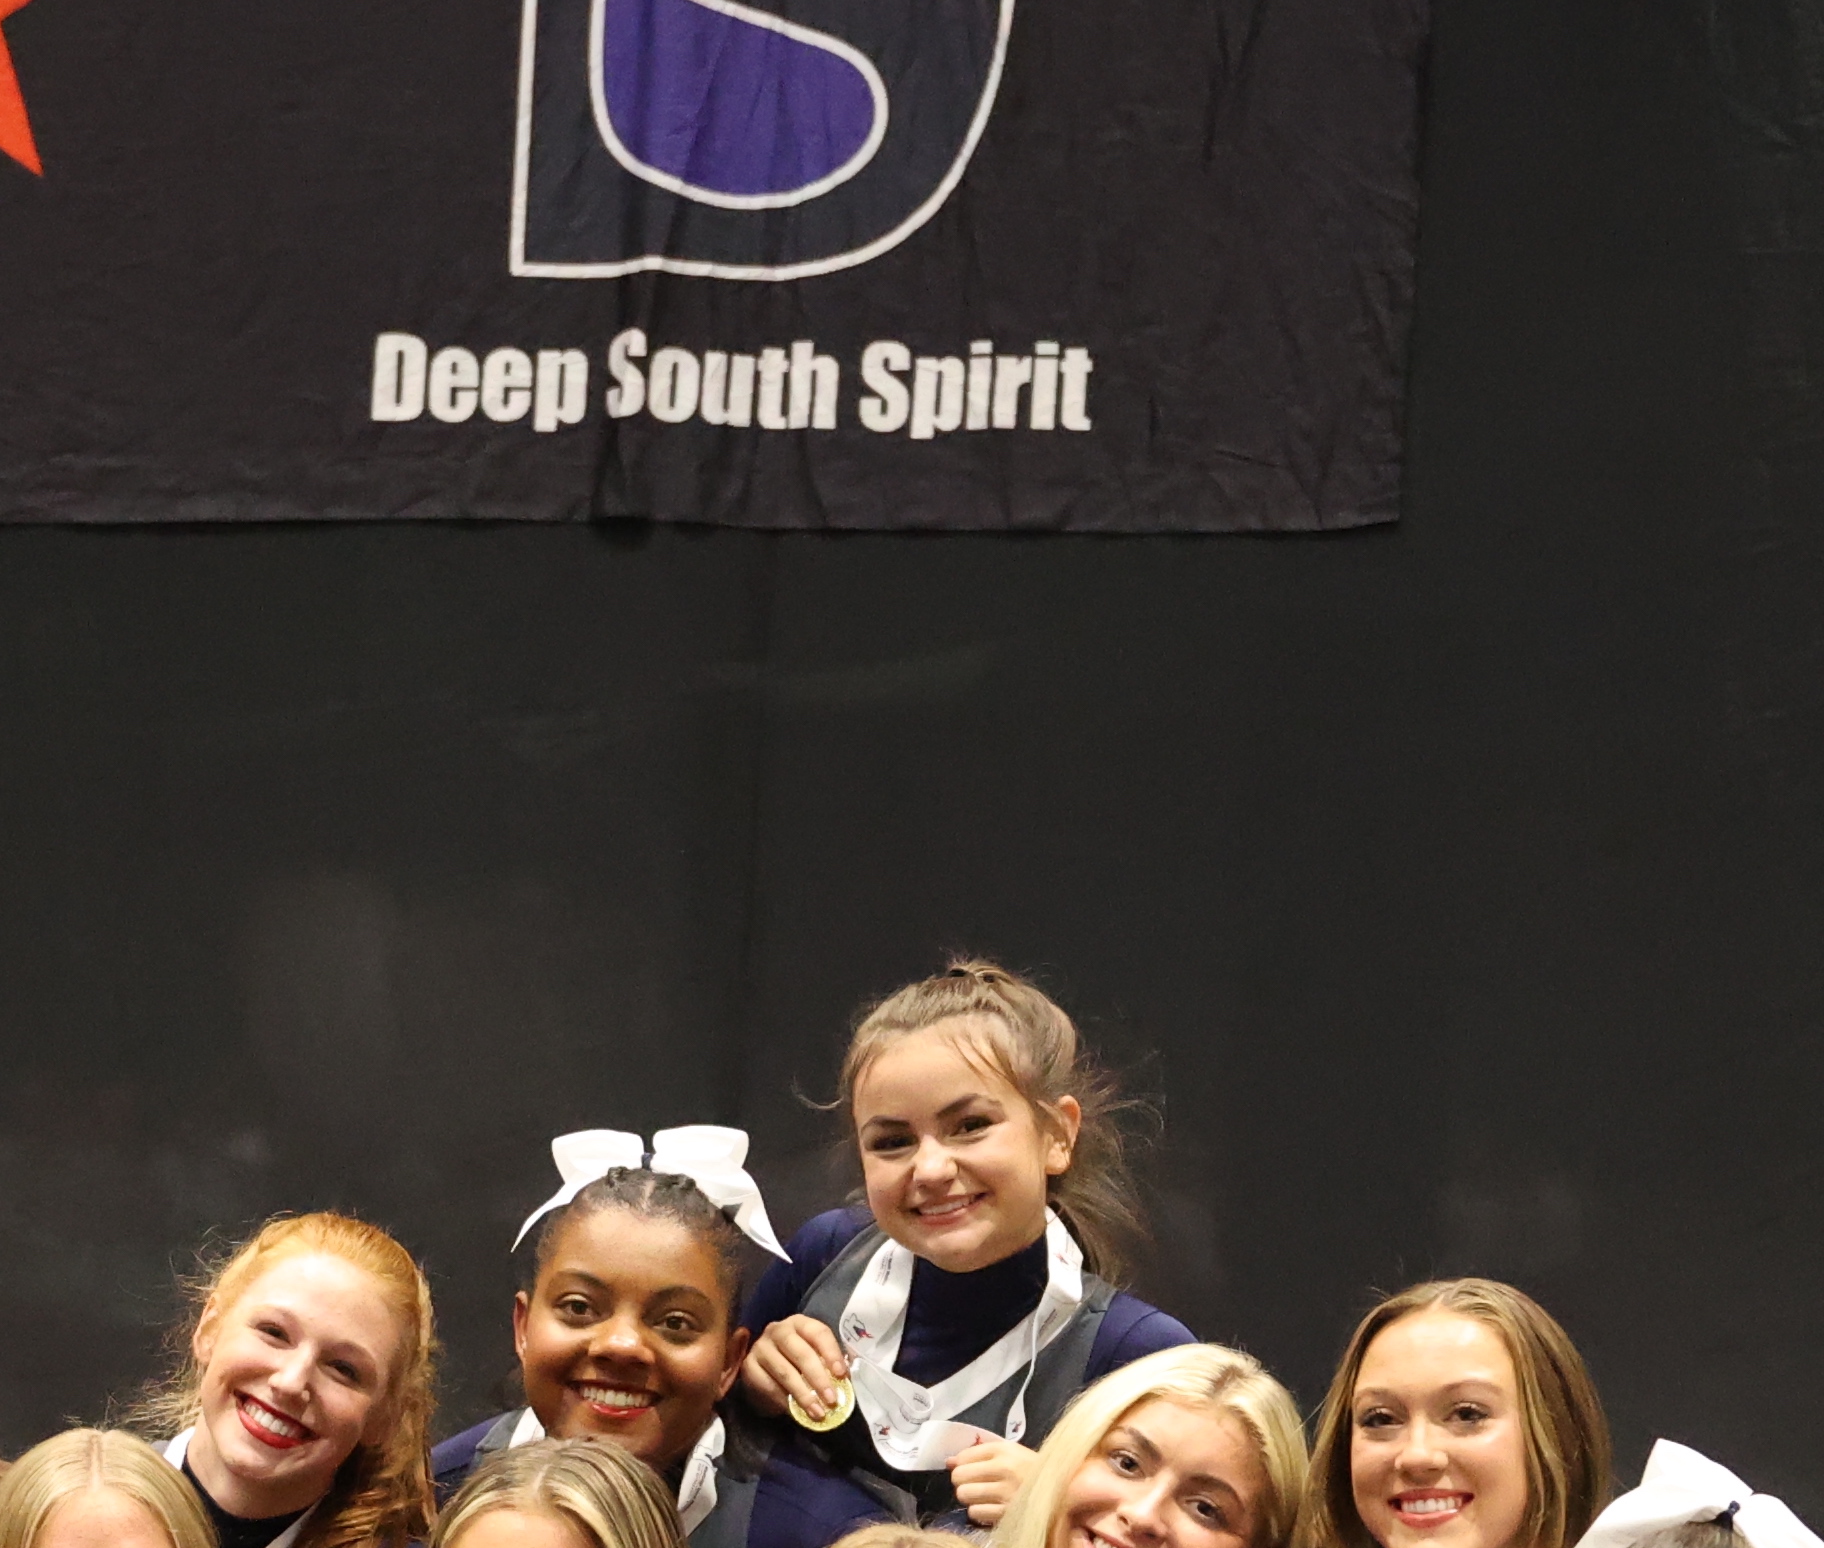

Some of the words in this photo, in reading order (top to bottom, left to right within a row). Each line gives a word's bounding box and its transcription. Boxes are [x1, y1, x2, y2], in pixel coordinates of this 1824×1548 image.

[371, 332, 588, 432] Deep
[606, 328, 839, 430] South
[859, 340, 1093, 440] Spirit
